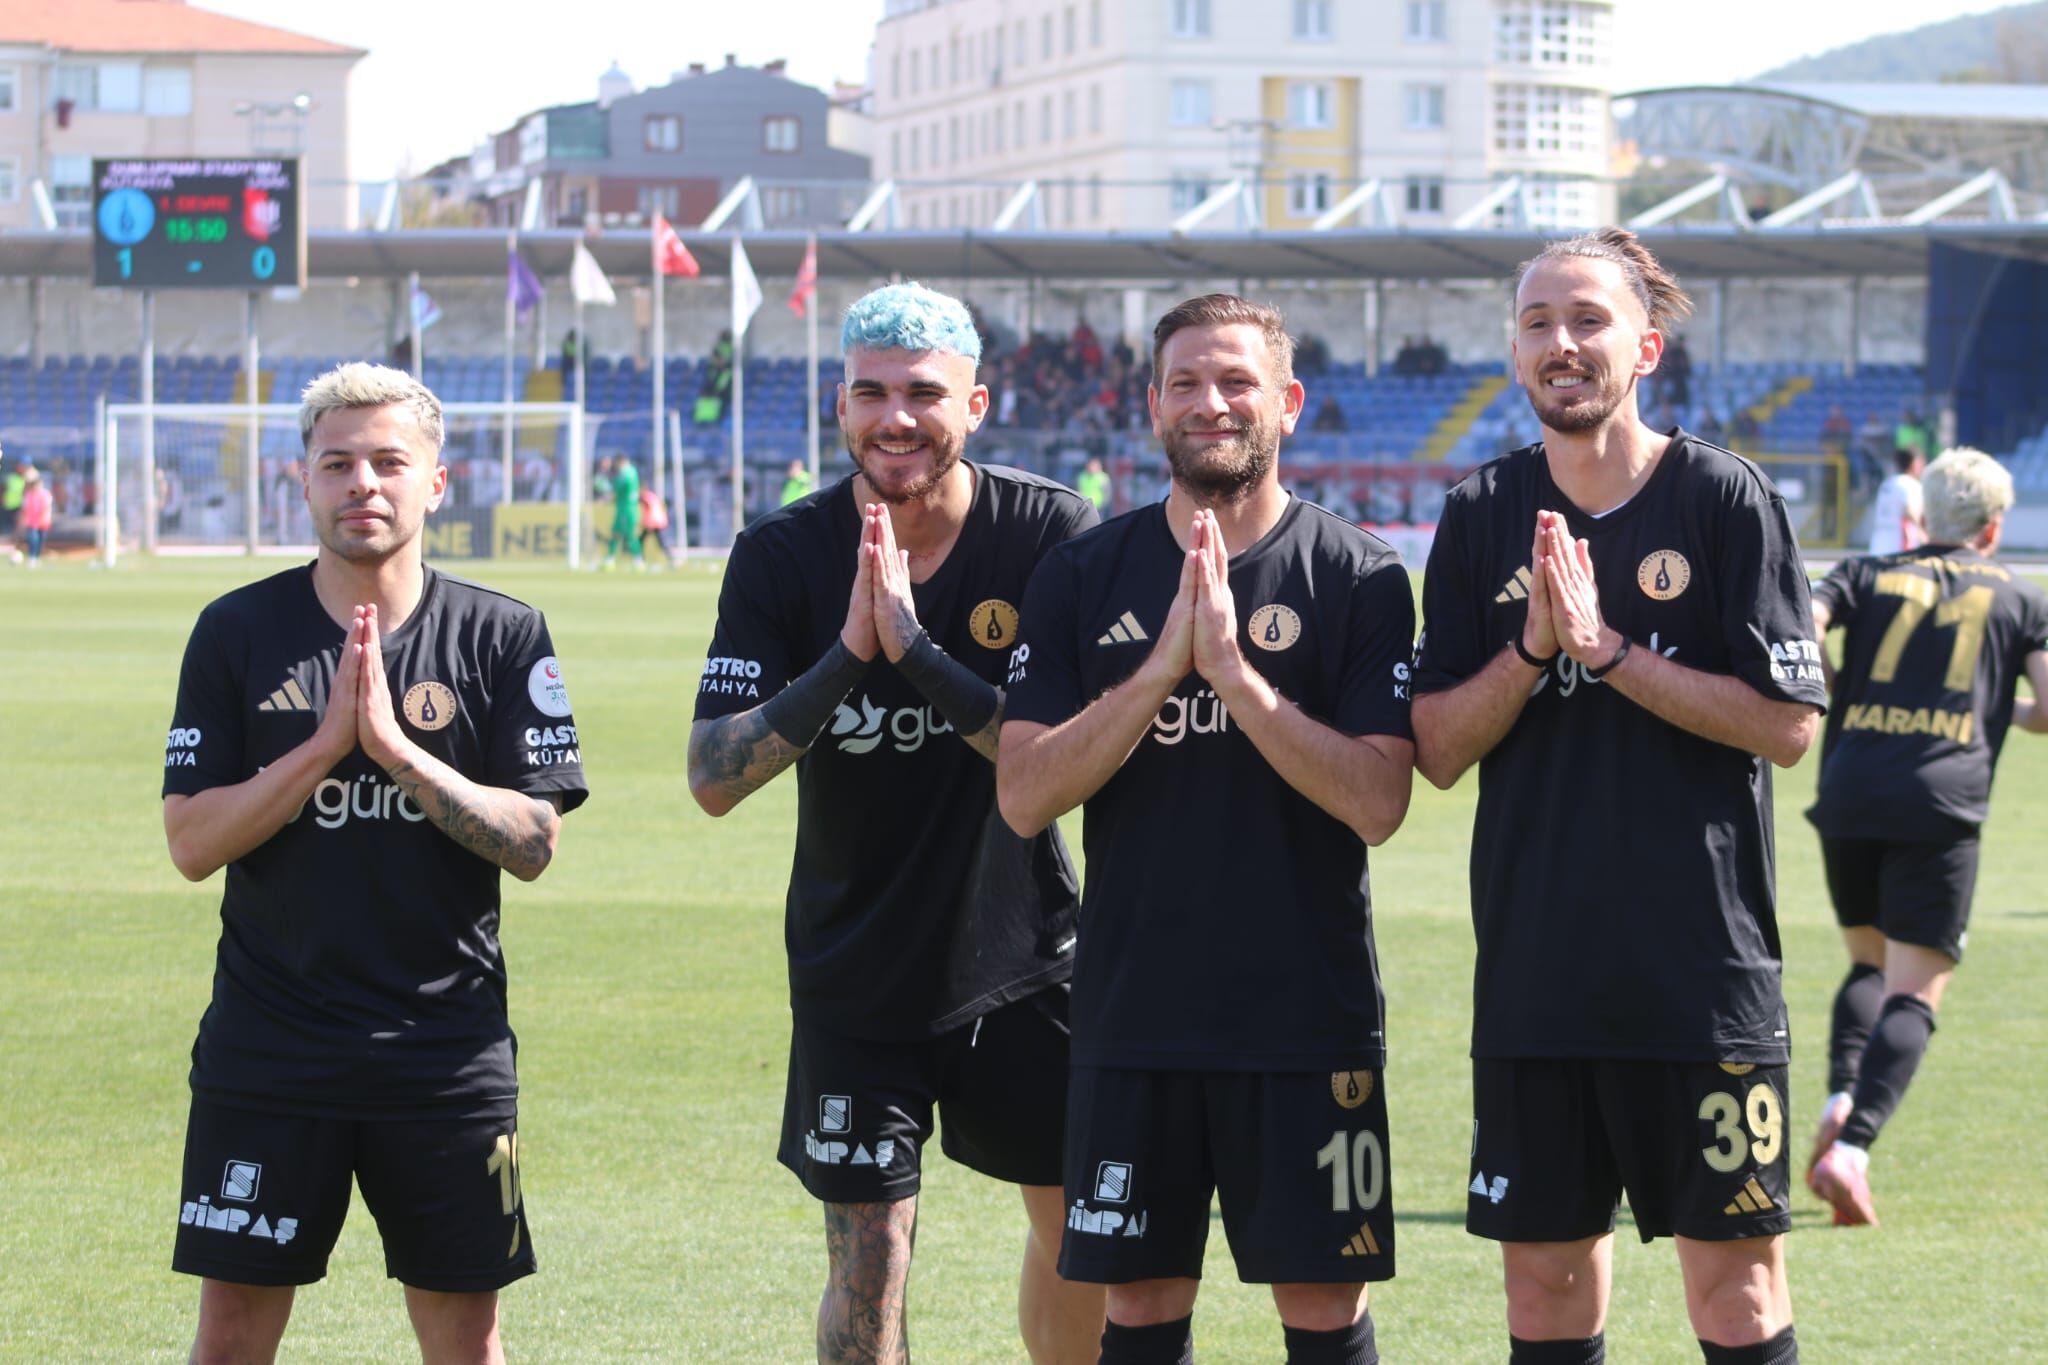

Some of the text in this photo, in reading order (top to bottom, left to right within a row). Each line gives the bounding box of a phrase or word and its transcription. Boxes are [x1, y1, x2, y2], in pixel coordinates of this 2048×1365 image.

[252, 246, 276, 280] 0
[1870, 572, 1995, 692] 71
[166, 751, 196, 767] HYA
[1698, 1082, 1783, 1172] 39
[1317, 1129, 1384, 1212] 10
